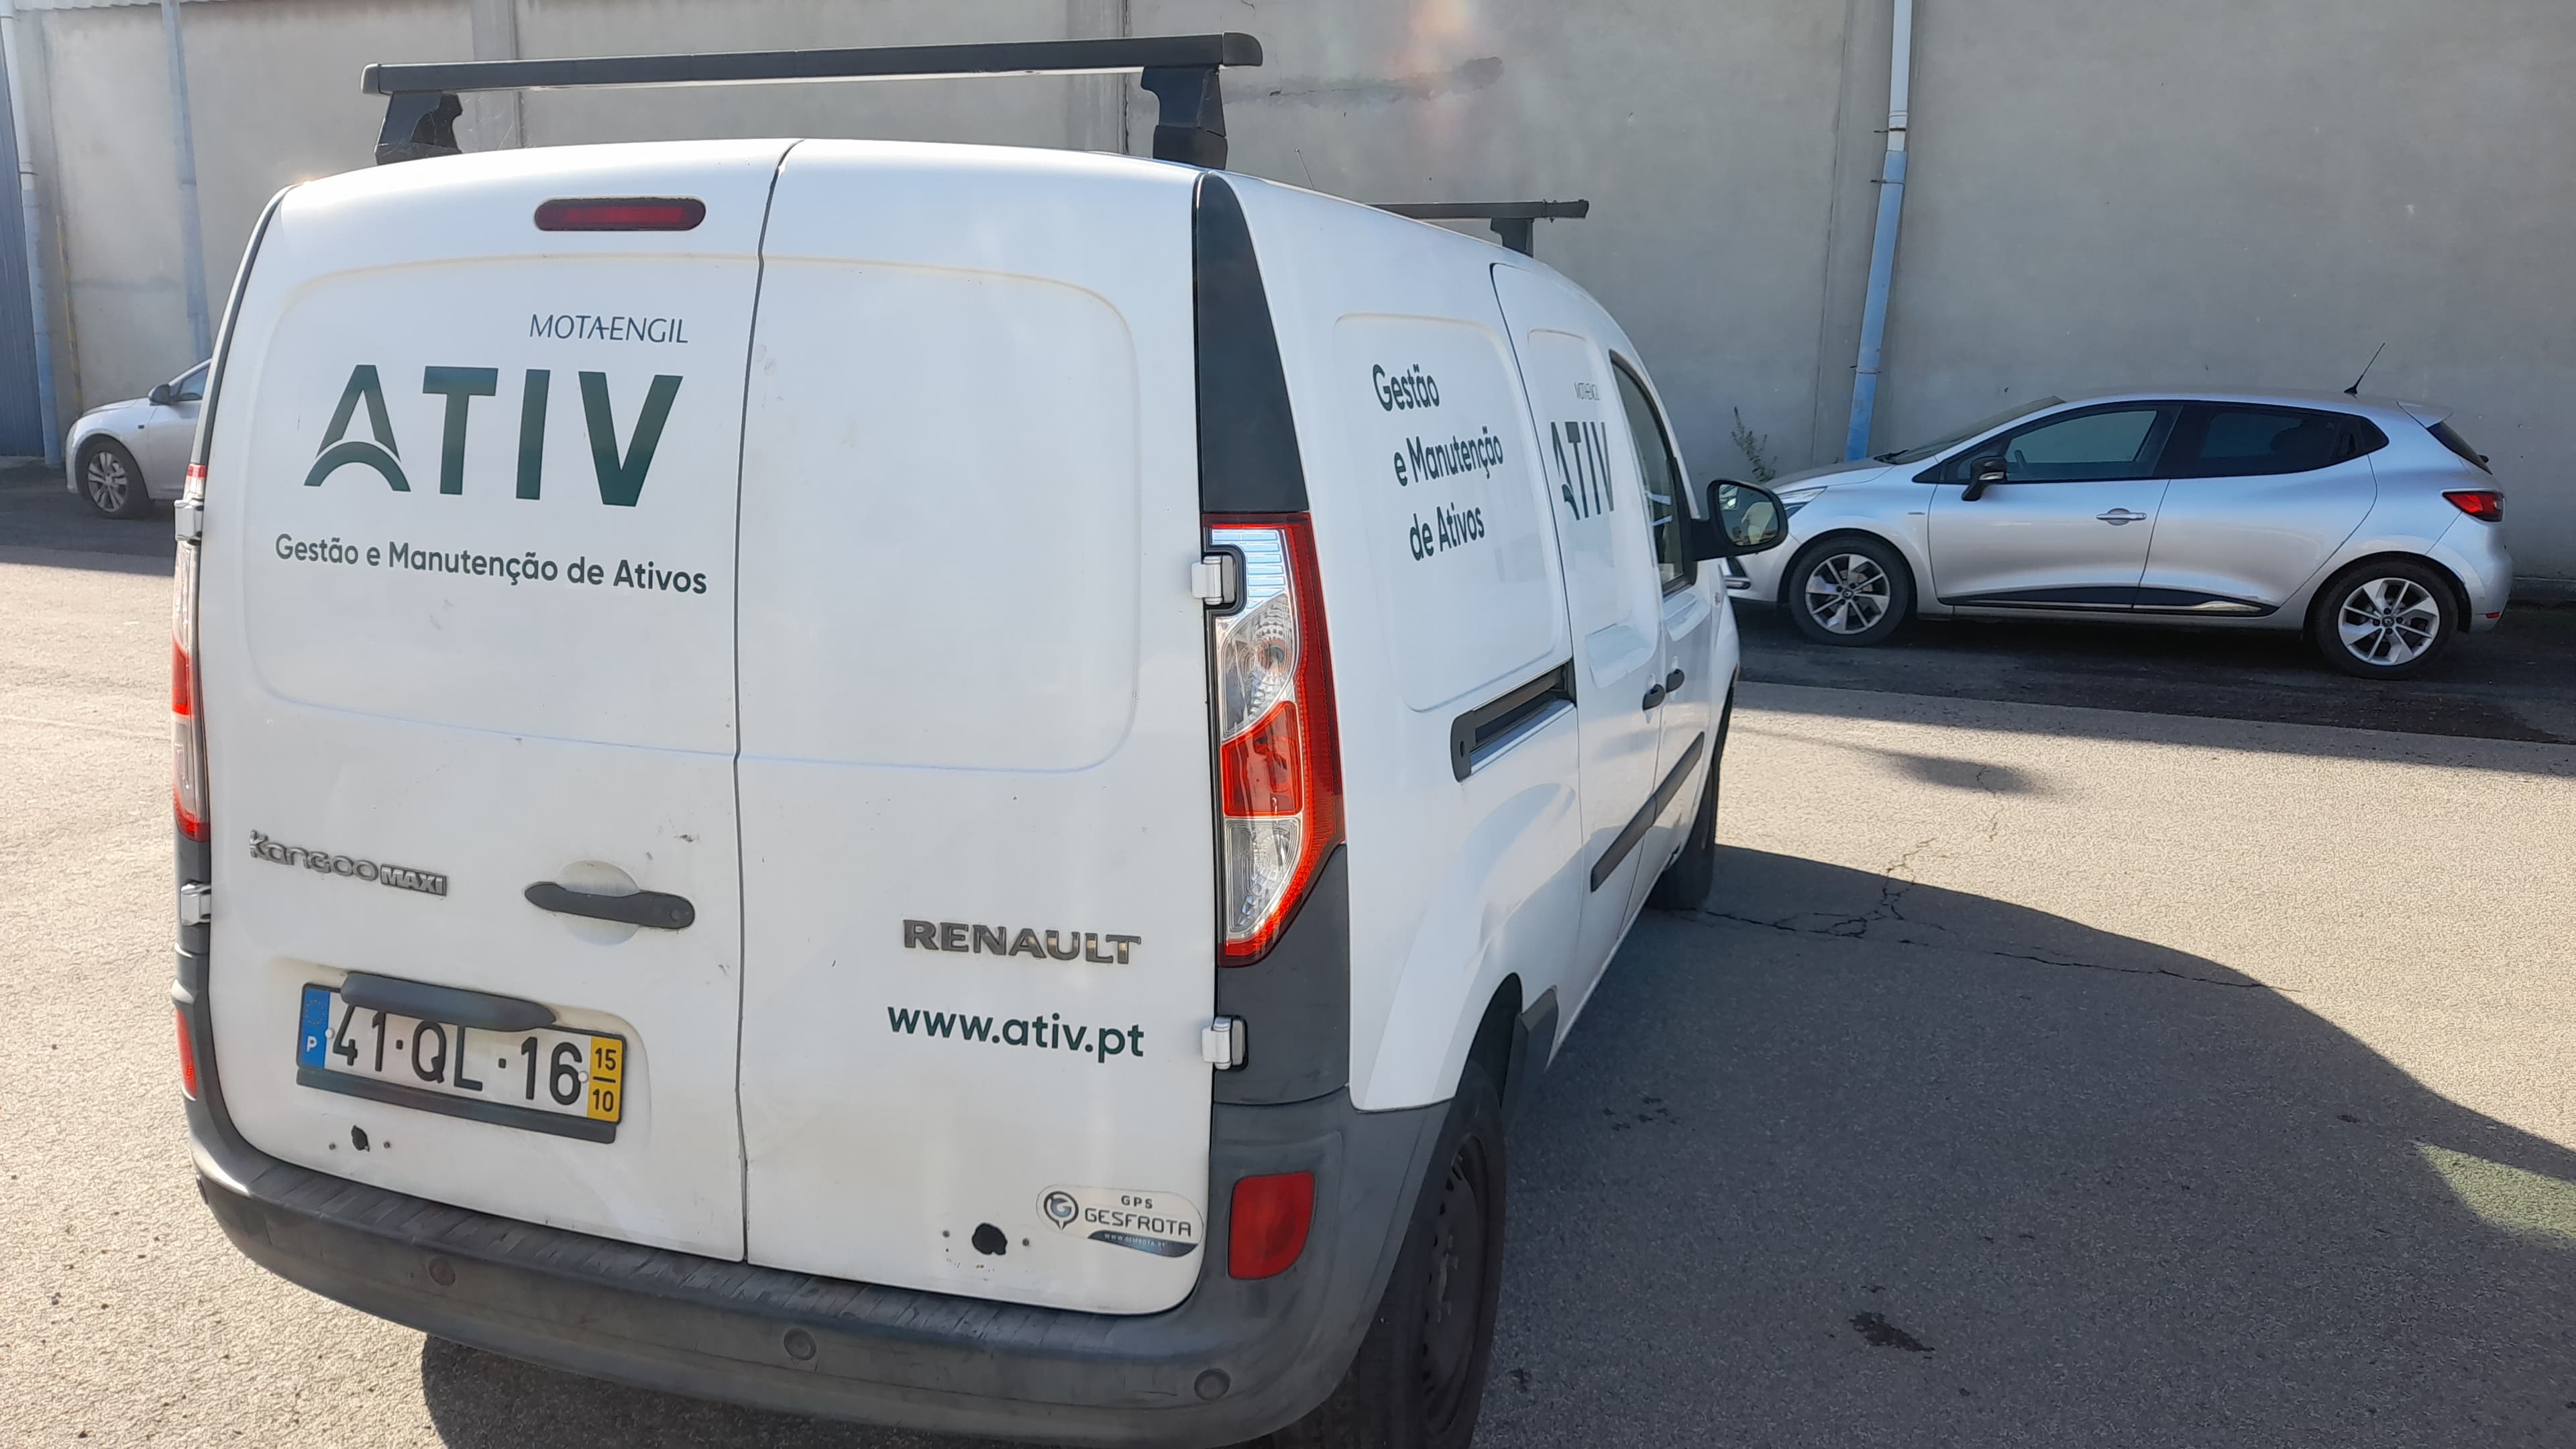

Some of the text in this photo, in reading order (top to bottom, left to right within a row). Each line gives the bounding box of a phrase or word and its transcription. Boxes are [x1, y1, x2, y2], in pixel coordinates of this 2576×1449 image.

[1372, 363, 1440, 412] Gestão
[303, 364, 684, 507] ATIV
[1393, 425, 1503, 486] e Manutenção
[1551, 421, 1614, 521] ATIV
[1409, 501, 1485, 561] de Ativos
[275, 533, 708, 595] Gestão e Manutenção de Ativos
[380, 863, 448, 897] MAXI
[903, 919, 1142, 965] RENAULT
[306, 1034, 319, 1053] P
[888, 1006, 1145, 1064] www.ativ.pt
[594, 1046, 616, 1072] 15
[592, 1088, 614, 1113] 10
[1084, 1208, 1191, 1237] GESFROTA
[1121, 1195, 1153, 1209] GPS
